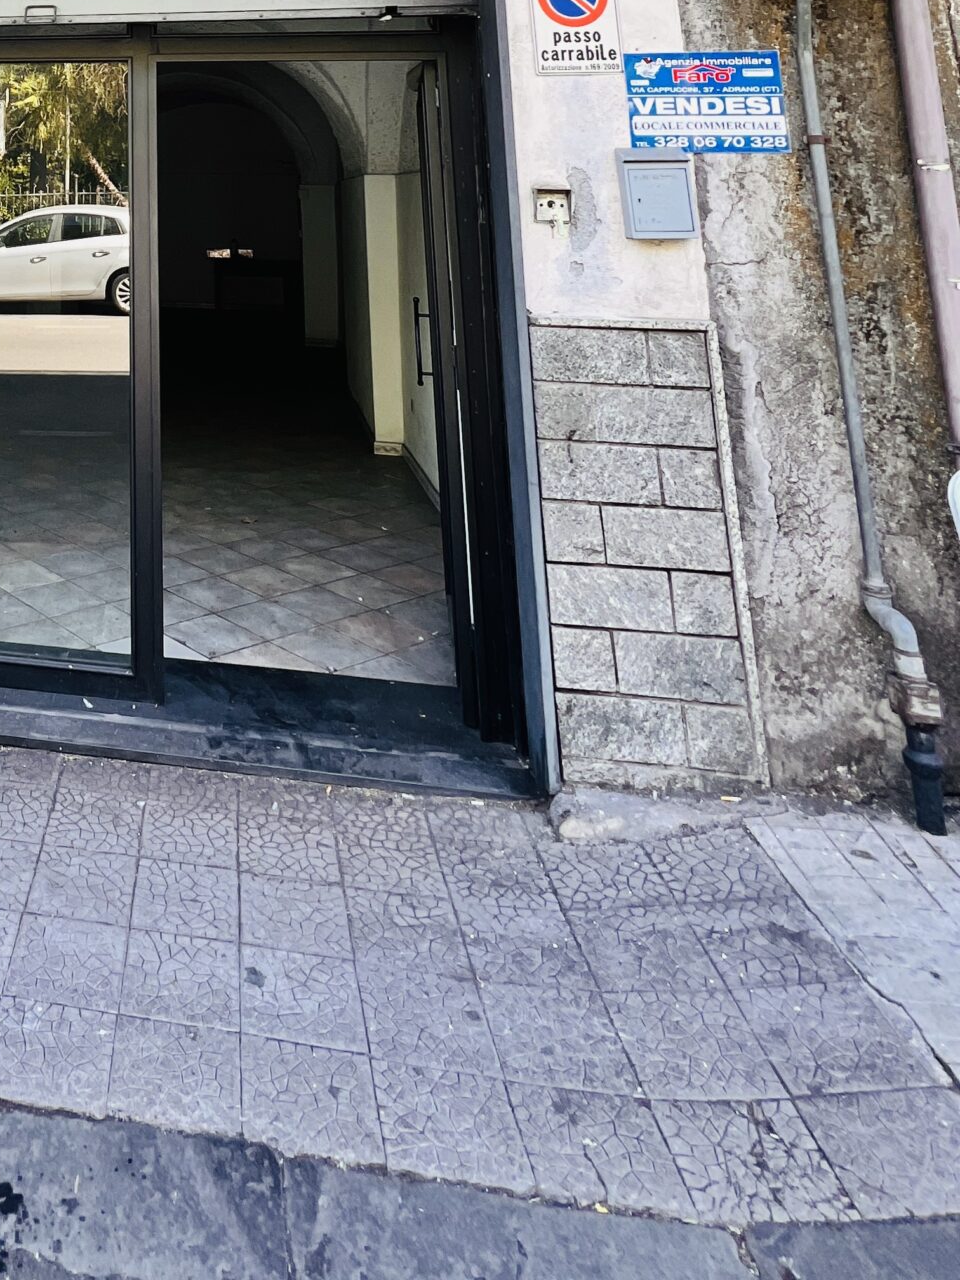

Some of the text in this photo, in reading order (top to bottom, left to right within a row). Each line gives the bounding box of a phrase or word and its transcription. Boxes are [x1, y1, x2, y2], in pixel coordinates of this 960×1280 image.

[553, 30, 602, 47] passo
[541, 44, 617, 62] carrabile
[655, 56, 772, 68] Agenzia Immobiliare
[672, 66, 732, 84] Faro
[722, 86, 760, 94] ADRANO
[761, 86, 780, 94] (CT)
[632, 96, 782, 116] VENDESI
[634, 121, 782, 131] LOCALE COMMERCIALE
[653, 136, 689, 148] 328
[693, 136, 717, 148] 06
[721, 136, 746, 148] 70
[750, 136, 788, 148] 328
